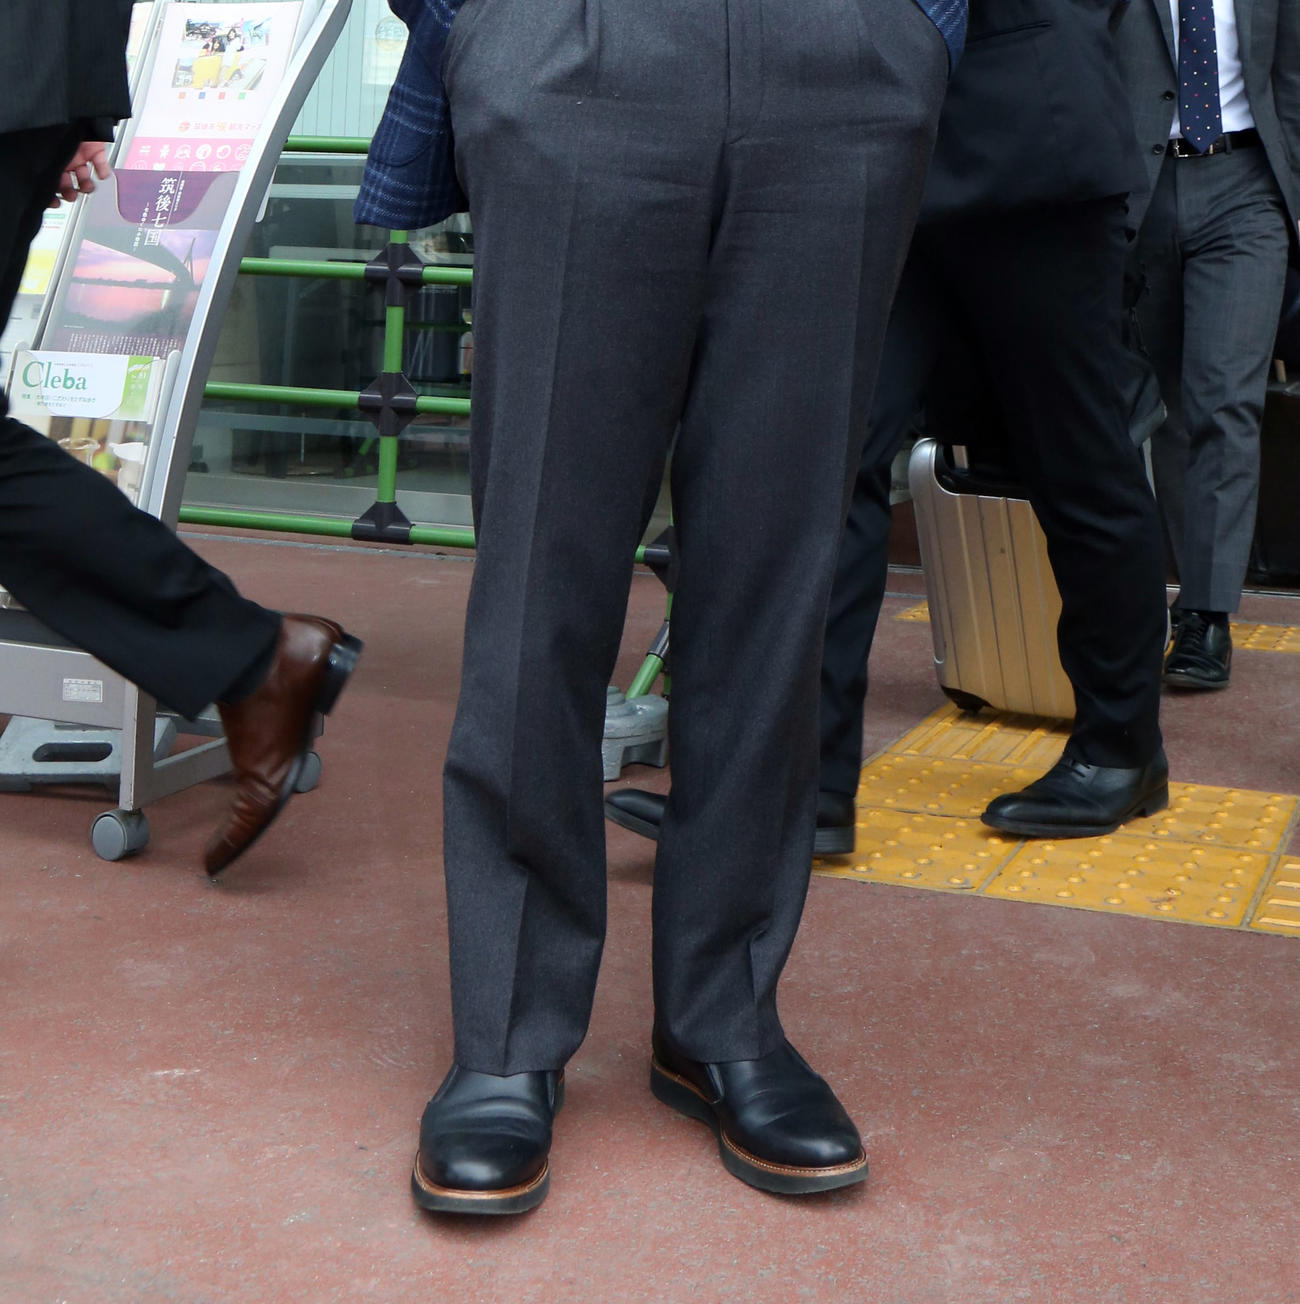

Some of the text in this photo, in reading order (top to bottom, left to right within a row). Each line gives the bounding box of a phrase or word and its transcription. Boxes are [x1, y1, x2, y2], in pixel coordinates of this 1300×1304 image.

[144, 177, 178, 246] 筑後七国
[22, 360, 87, 390] Cleba
